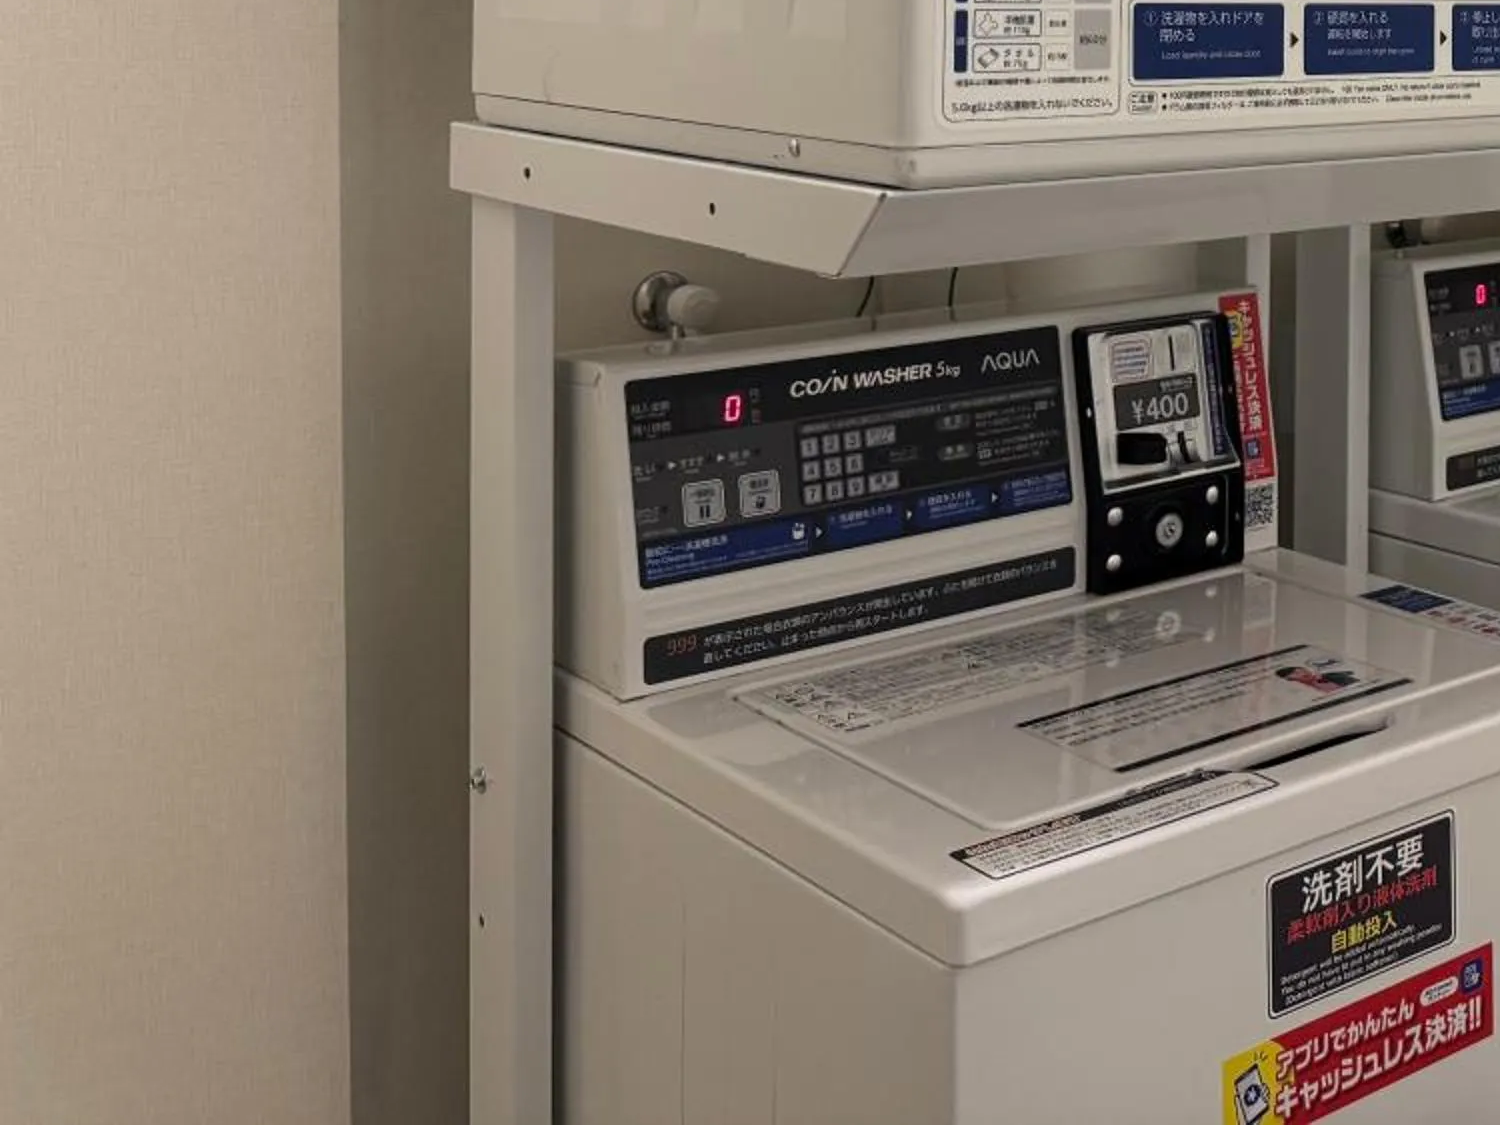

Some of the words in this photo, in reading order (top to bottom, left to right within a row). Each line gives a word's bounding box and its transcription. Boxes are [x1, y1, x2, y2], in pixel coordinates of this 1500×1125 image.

[790, 368, 848, 398] COIN
[853, 362, 932, 389] WASHER
[981, 348, 1041, 373] AQUA
[724, 394, 742, 422] 0
[1131, 392, 1189, 426] ¥400
[1302, 834, 1424, 913] 洗剤不要
[1287, 865, 1437, 945] 柔軟剤入り液体洗剤
[1332, 911, 1397, 953] 自動投入
[1276, 997, 1414, 1083] アプリでかんたん
